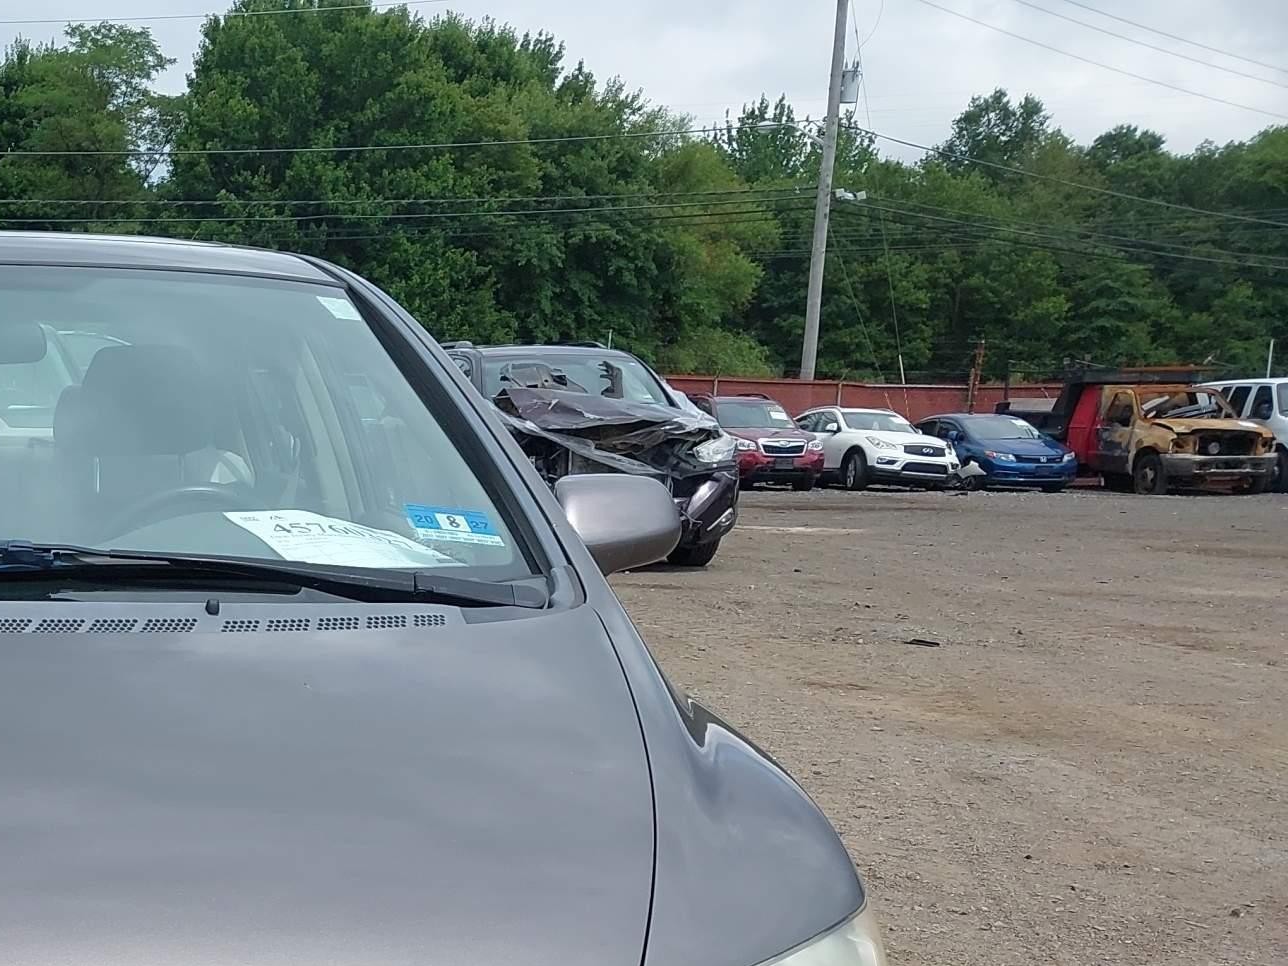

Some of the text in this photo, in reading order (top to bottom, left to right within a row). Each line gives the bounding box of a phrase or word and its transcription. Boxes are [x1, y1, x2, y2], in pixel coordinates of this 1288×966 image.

[414, 514, 489, 530] 20 8 27
